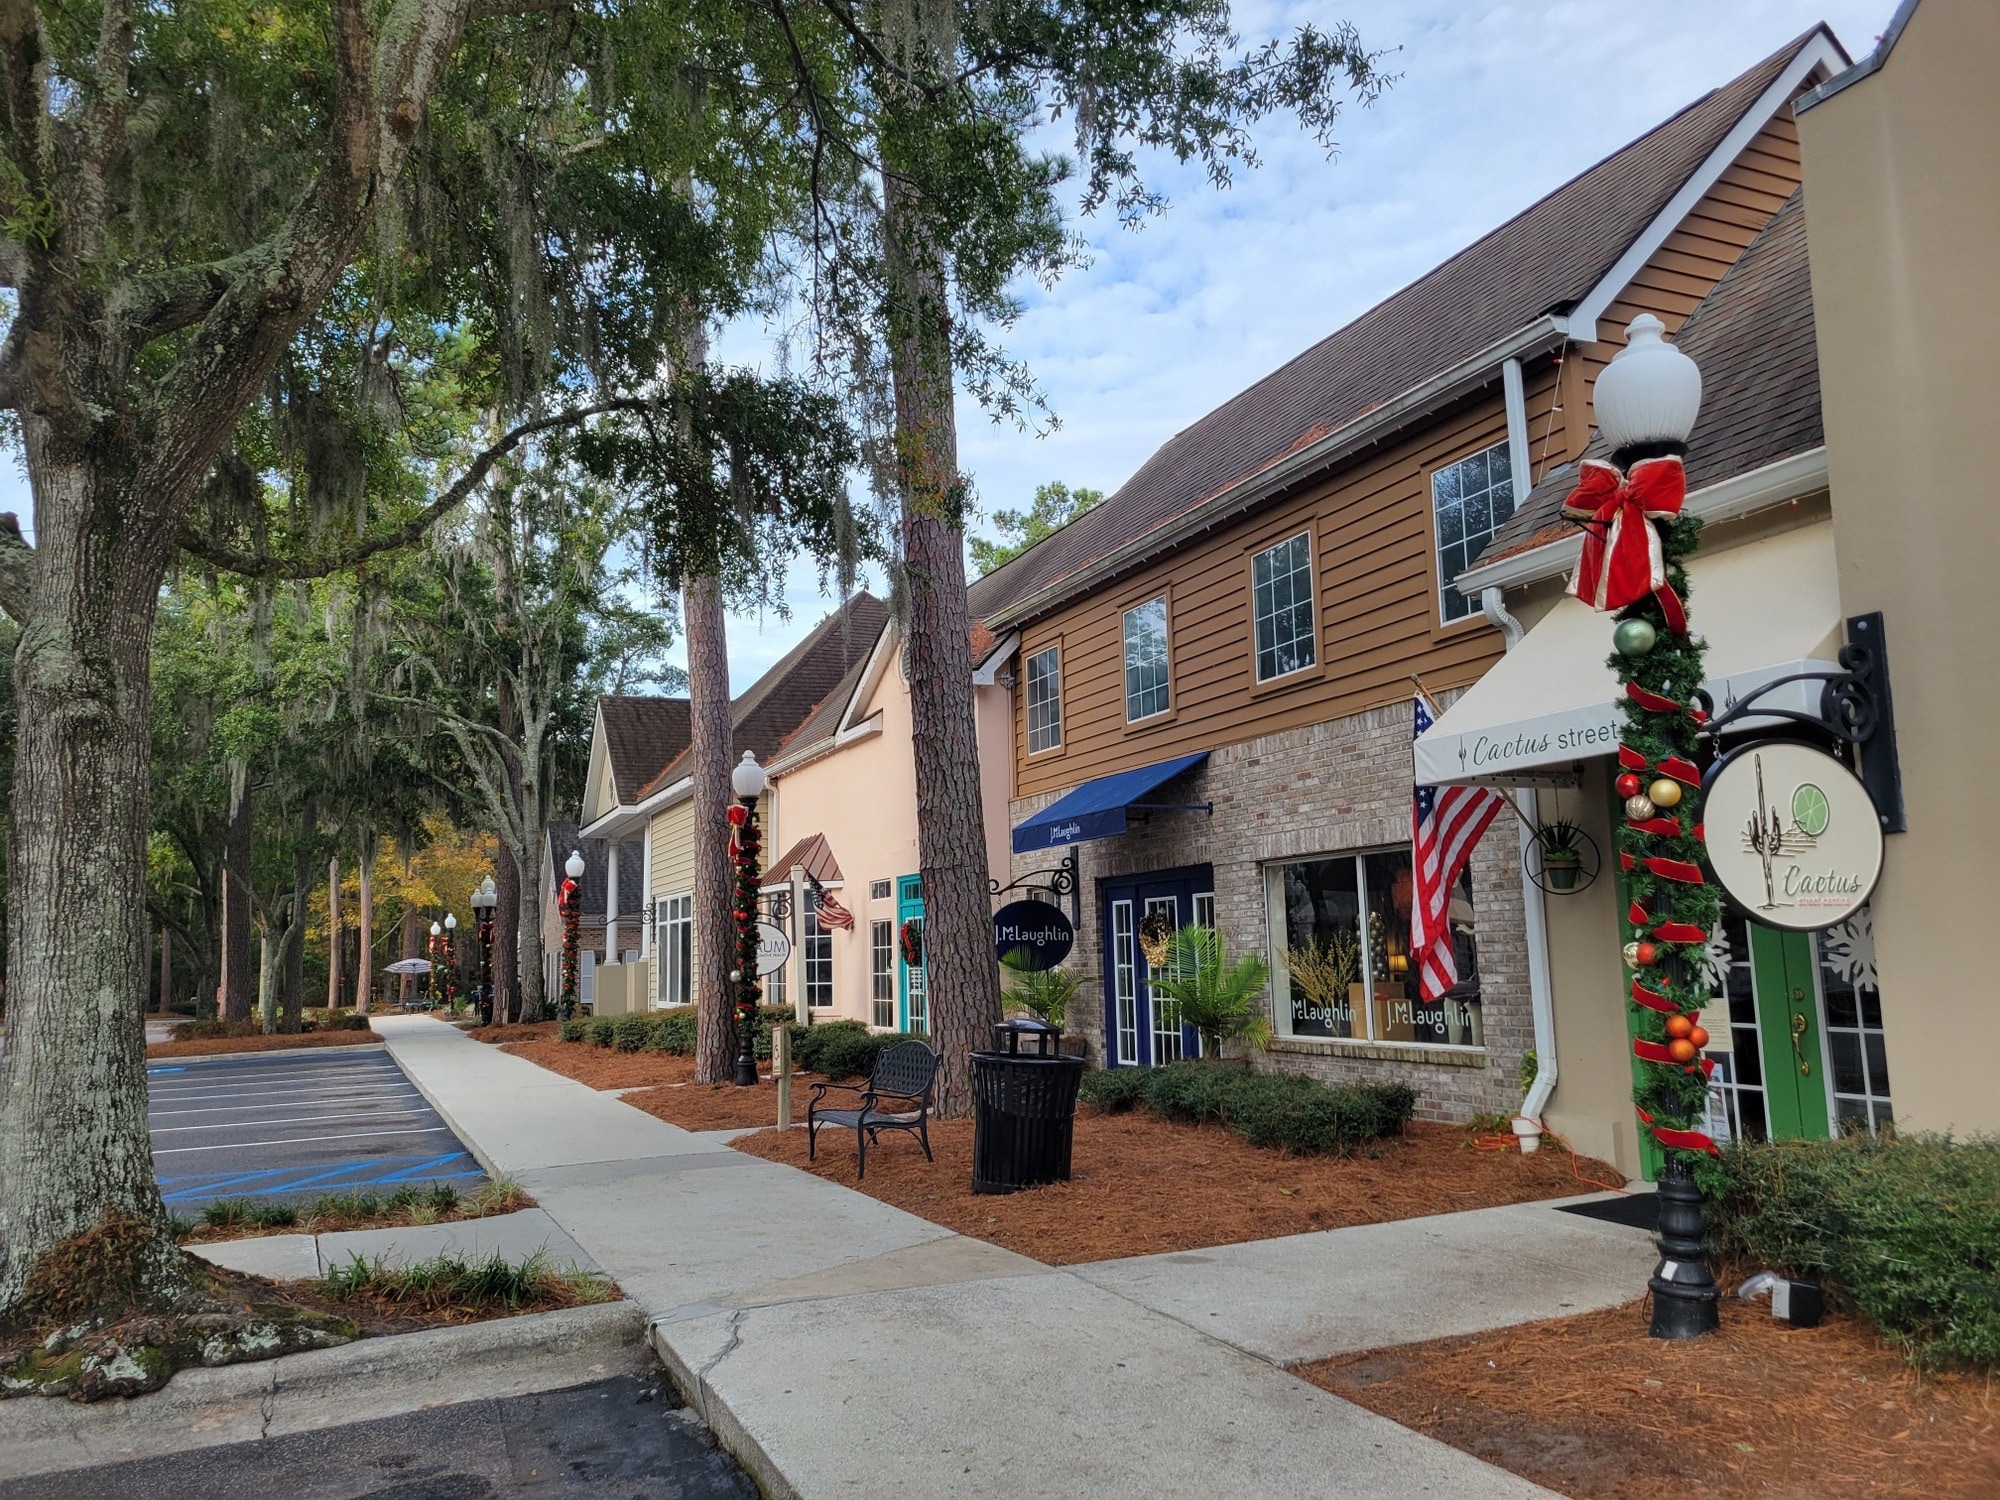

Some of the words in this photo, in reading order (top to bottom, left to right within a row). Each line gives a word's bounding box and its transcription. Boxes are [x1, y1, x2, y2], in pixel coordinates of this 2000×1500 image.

[1473, 733, 1551, 766] Cactus
[1558, 719, 1618, 750] street
[1785, 865, 1862, 896] Cactus
